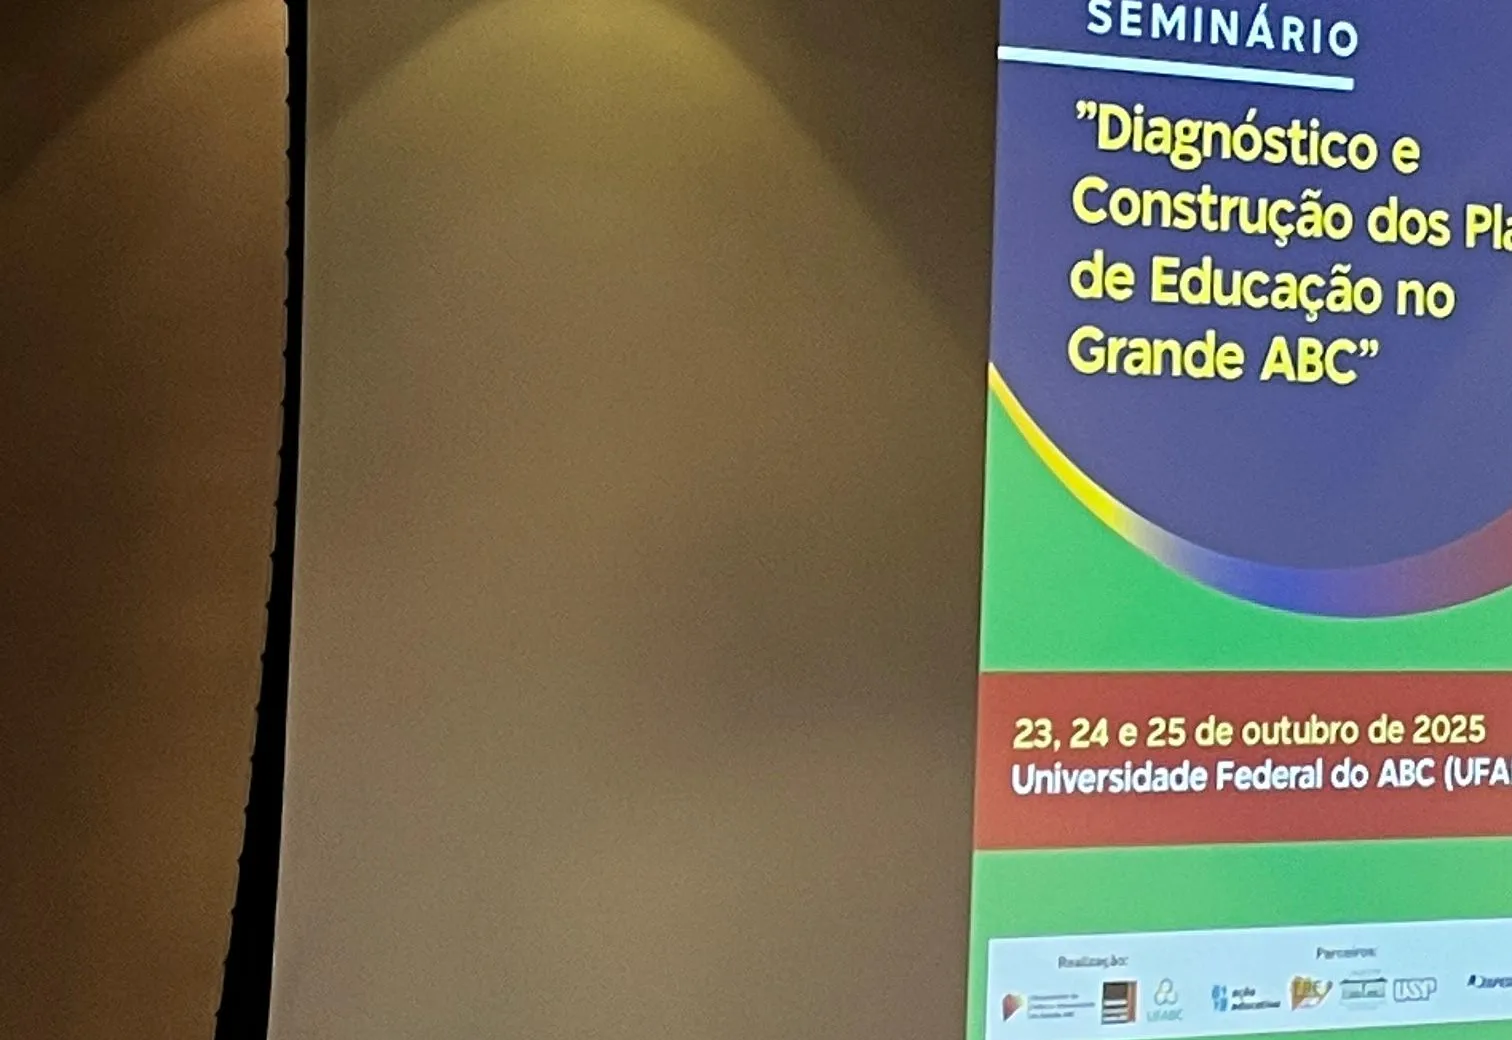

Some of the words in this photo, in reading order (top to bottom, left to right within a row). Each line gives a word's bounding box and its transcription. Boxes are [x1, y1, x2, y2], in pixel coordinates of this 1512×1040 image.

[1086, 0, 1359, 58] SEMINÁRIO
[1391, 136, 1421, 174] e
[1072, 175, 1354, 248] Construção
[1367, 195, 1451, 247] dos
[1069, 248, 1135, 302] de
[1150, 255, 1383, 323] Educação
[1396, 279, 1456, 319] no
[1067, 324, 1245, 380] Grande
[1012, 717, 1061, 752] 23,
[1069, 716, 1110, 749] 24
[1118, 722, 1138, 747] e
[1146, 716, 1187, 747] 25
[1194, 714, 1234, 747] de
[1241, 713, 1360, 747] outubro
[1367, 712, 1405, 744] de
[1412, 713, 1487, 744] 2025
[1011, 757, 1209, 795] Universidade
[1216, 755, 1323, 791] Federal
[1330, 756, 1369, 788] do
[1376, 754, 1436, 788] ABC
